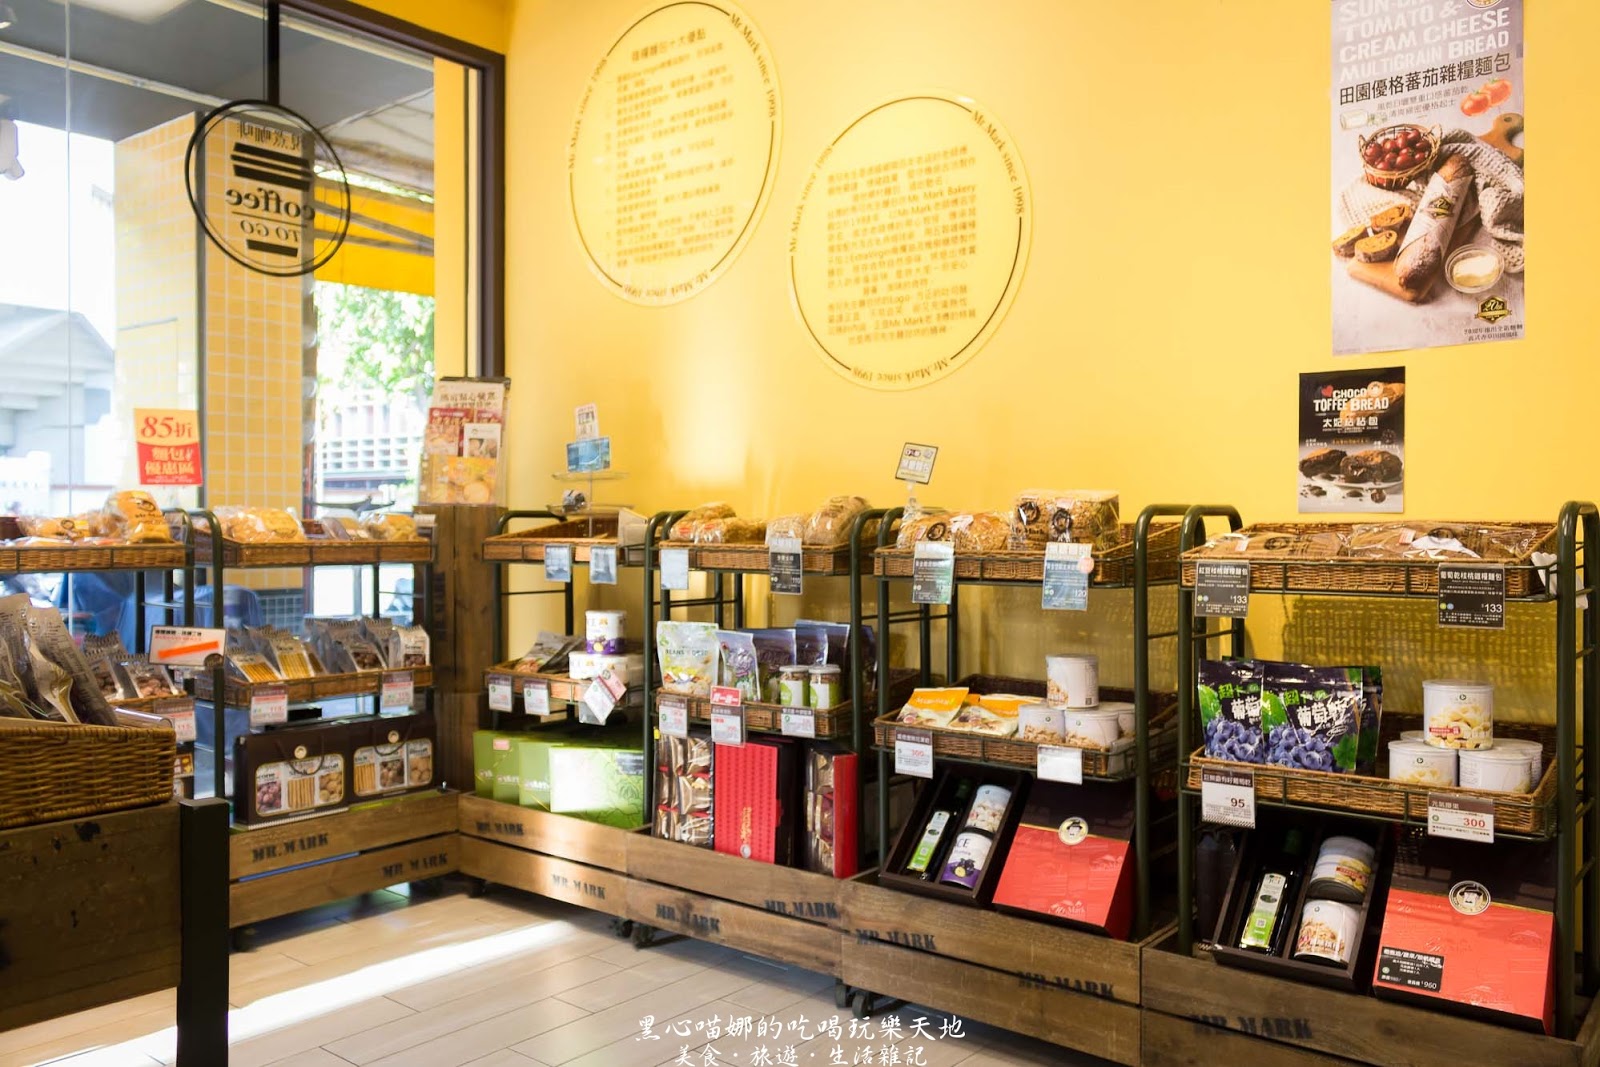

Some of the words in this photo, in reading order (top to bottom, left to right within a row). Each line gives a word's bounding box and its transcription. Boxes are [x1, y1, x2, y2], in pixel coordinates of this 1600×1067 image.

[1341, 5, 1433, 43] TOMATO
[1439, 4, 1462, 18] &
[1339, 30, 1418, 64] CREAM
[1422, 7, 1510, 44] CHEESE
[1340, 46, 1442, 83] MULTIGRAIN
[1449, 30, 1510, 59] BREAD
[1339, 53, 1511, 106] 田園優格蕃茄雜糧麵包
[1313, 398, 1348, 412] TOFFEE
[1350, 396, 1389, 411] BREAD
[1332, 387, 1367, 400] CHOCO
[140, 416, 192, 439] 85折
[1230, 797, 1245, 808] 95
[1463, 817, 1486, 828] 300
